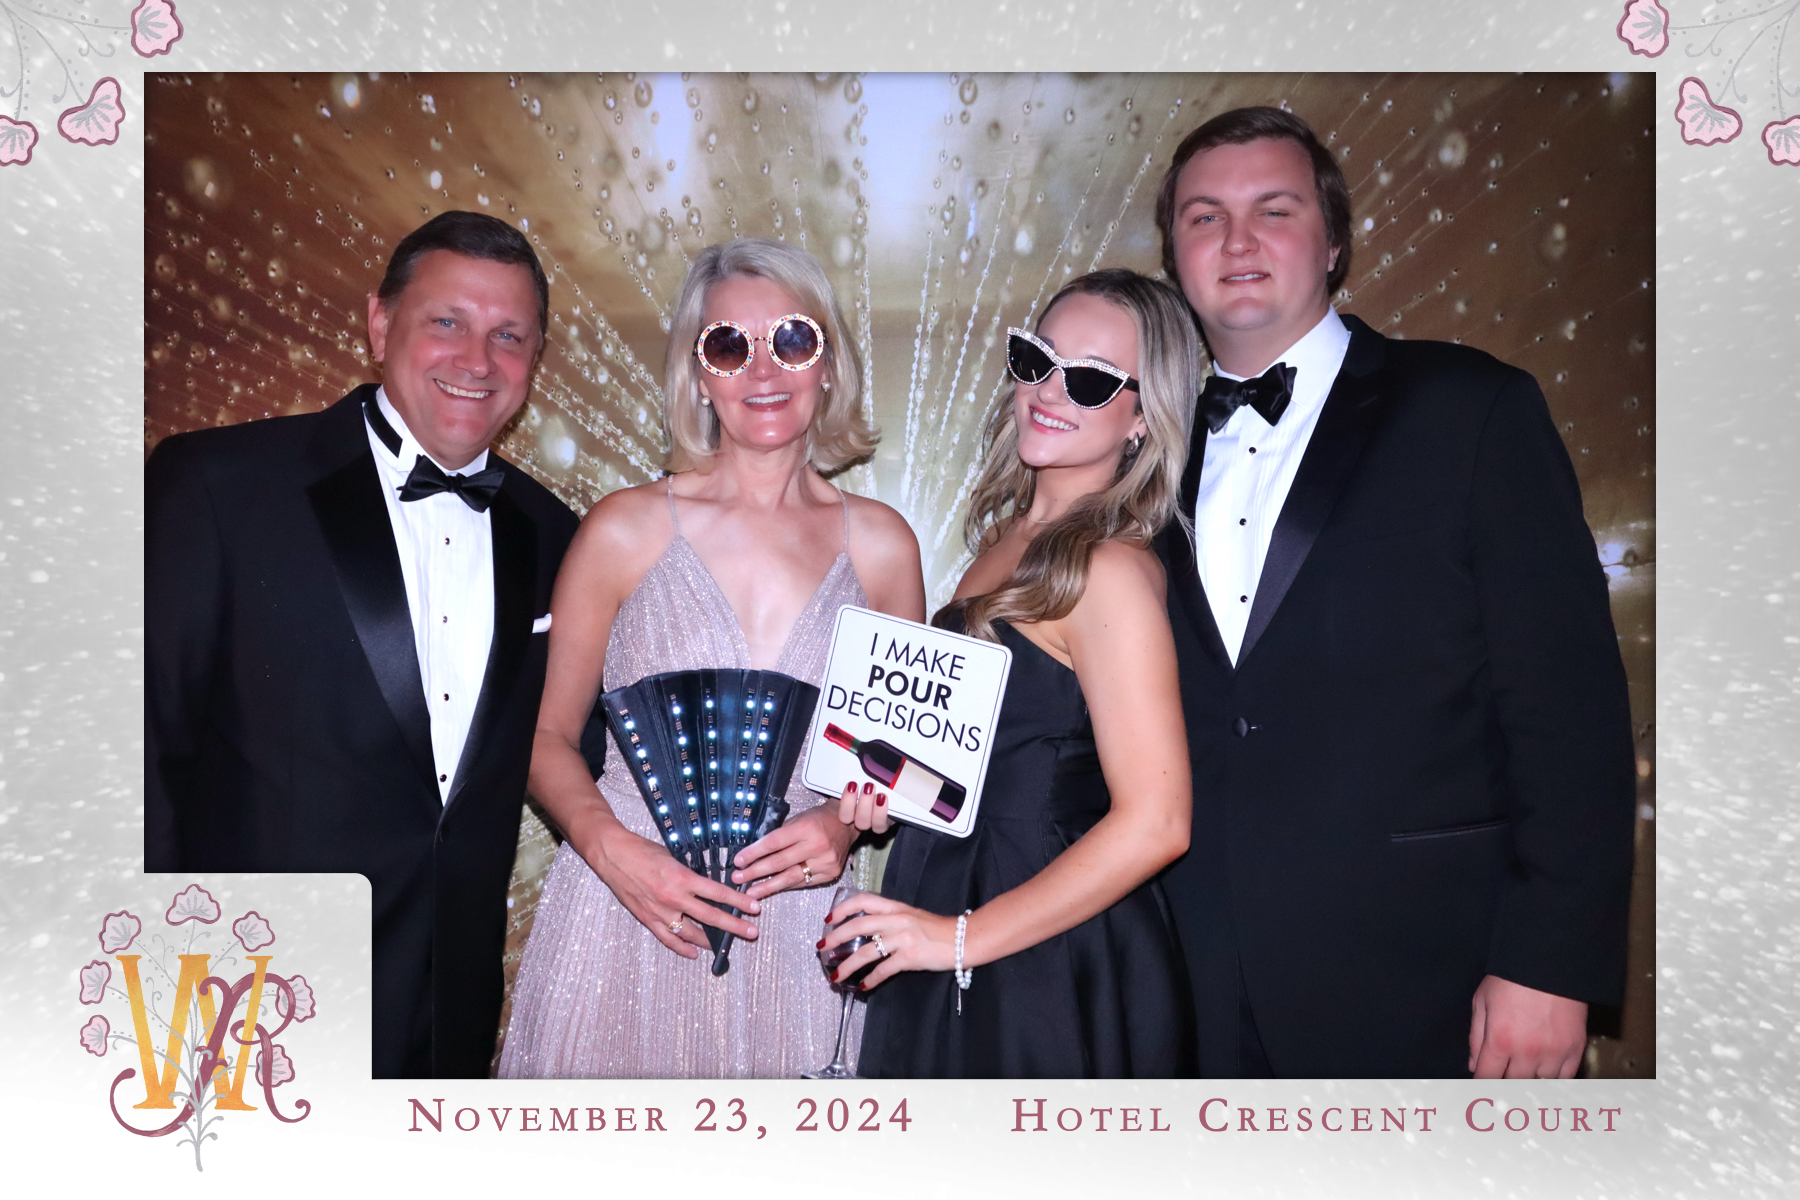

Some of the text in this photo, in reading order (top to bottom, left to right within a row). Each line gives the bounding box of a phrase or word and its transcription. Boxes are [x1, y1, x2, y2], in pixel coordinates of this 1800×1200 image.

[870, 633, 966, 681] I MAKE
[867, 664, 952, 711] POUR
[826, 684, 982, 752] DECISIONS
